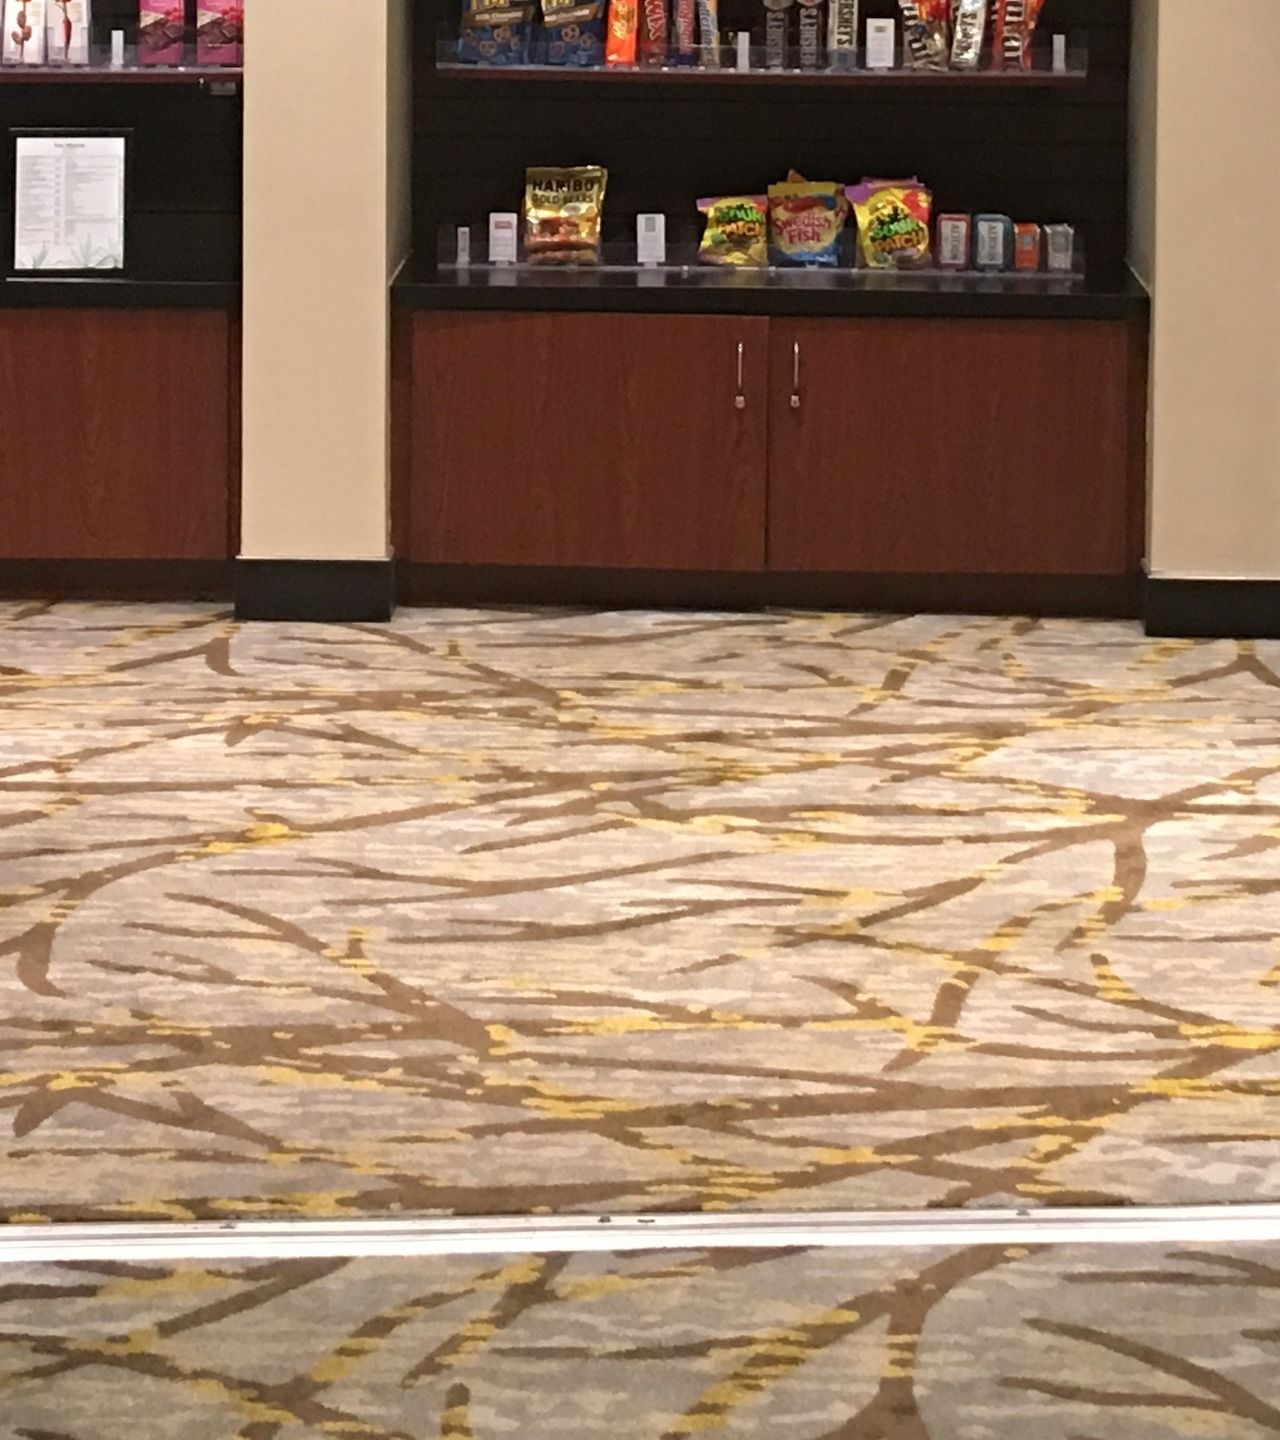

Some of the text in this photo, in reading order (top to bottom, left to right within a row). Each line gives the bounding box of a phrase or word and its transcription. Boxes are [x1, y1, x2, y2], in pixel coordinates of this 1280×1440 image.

[532, 178, 594, 192] HARIBO
[775, 210, 832, 235] Swedish
[787, 228, 821, 244] Fish
